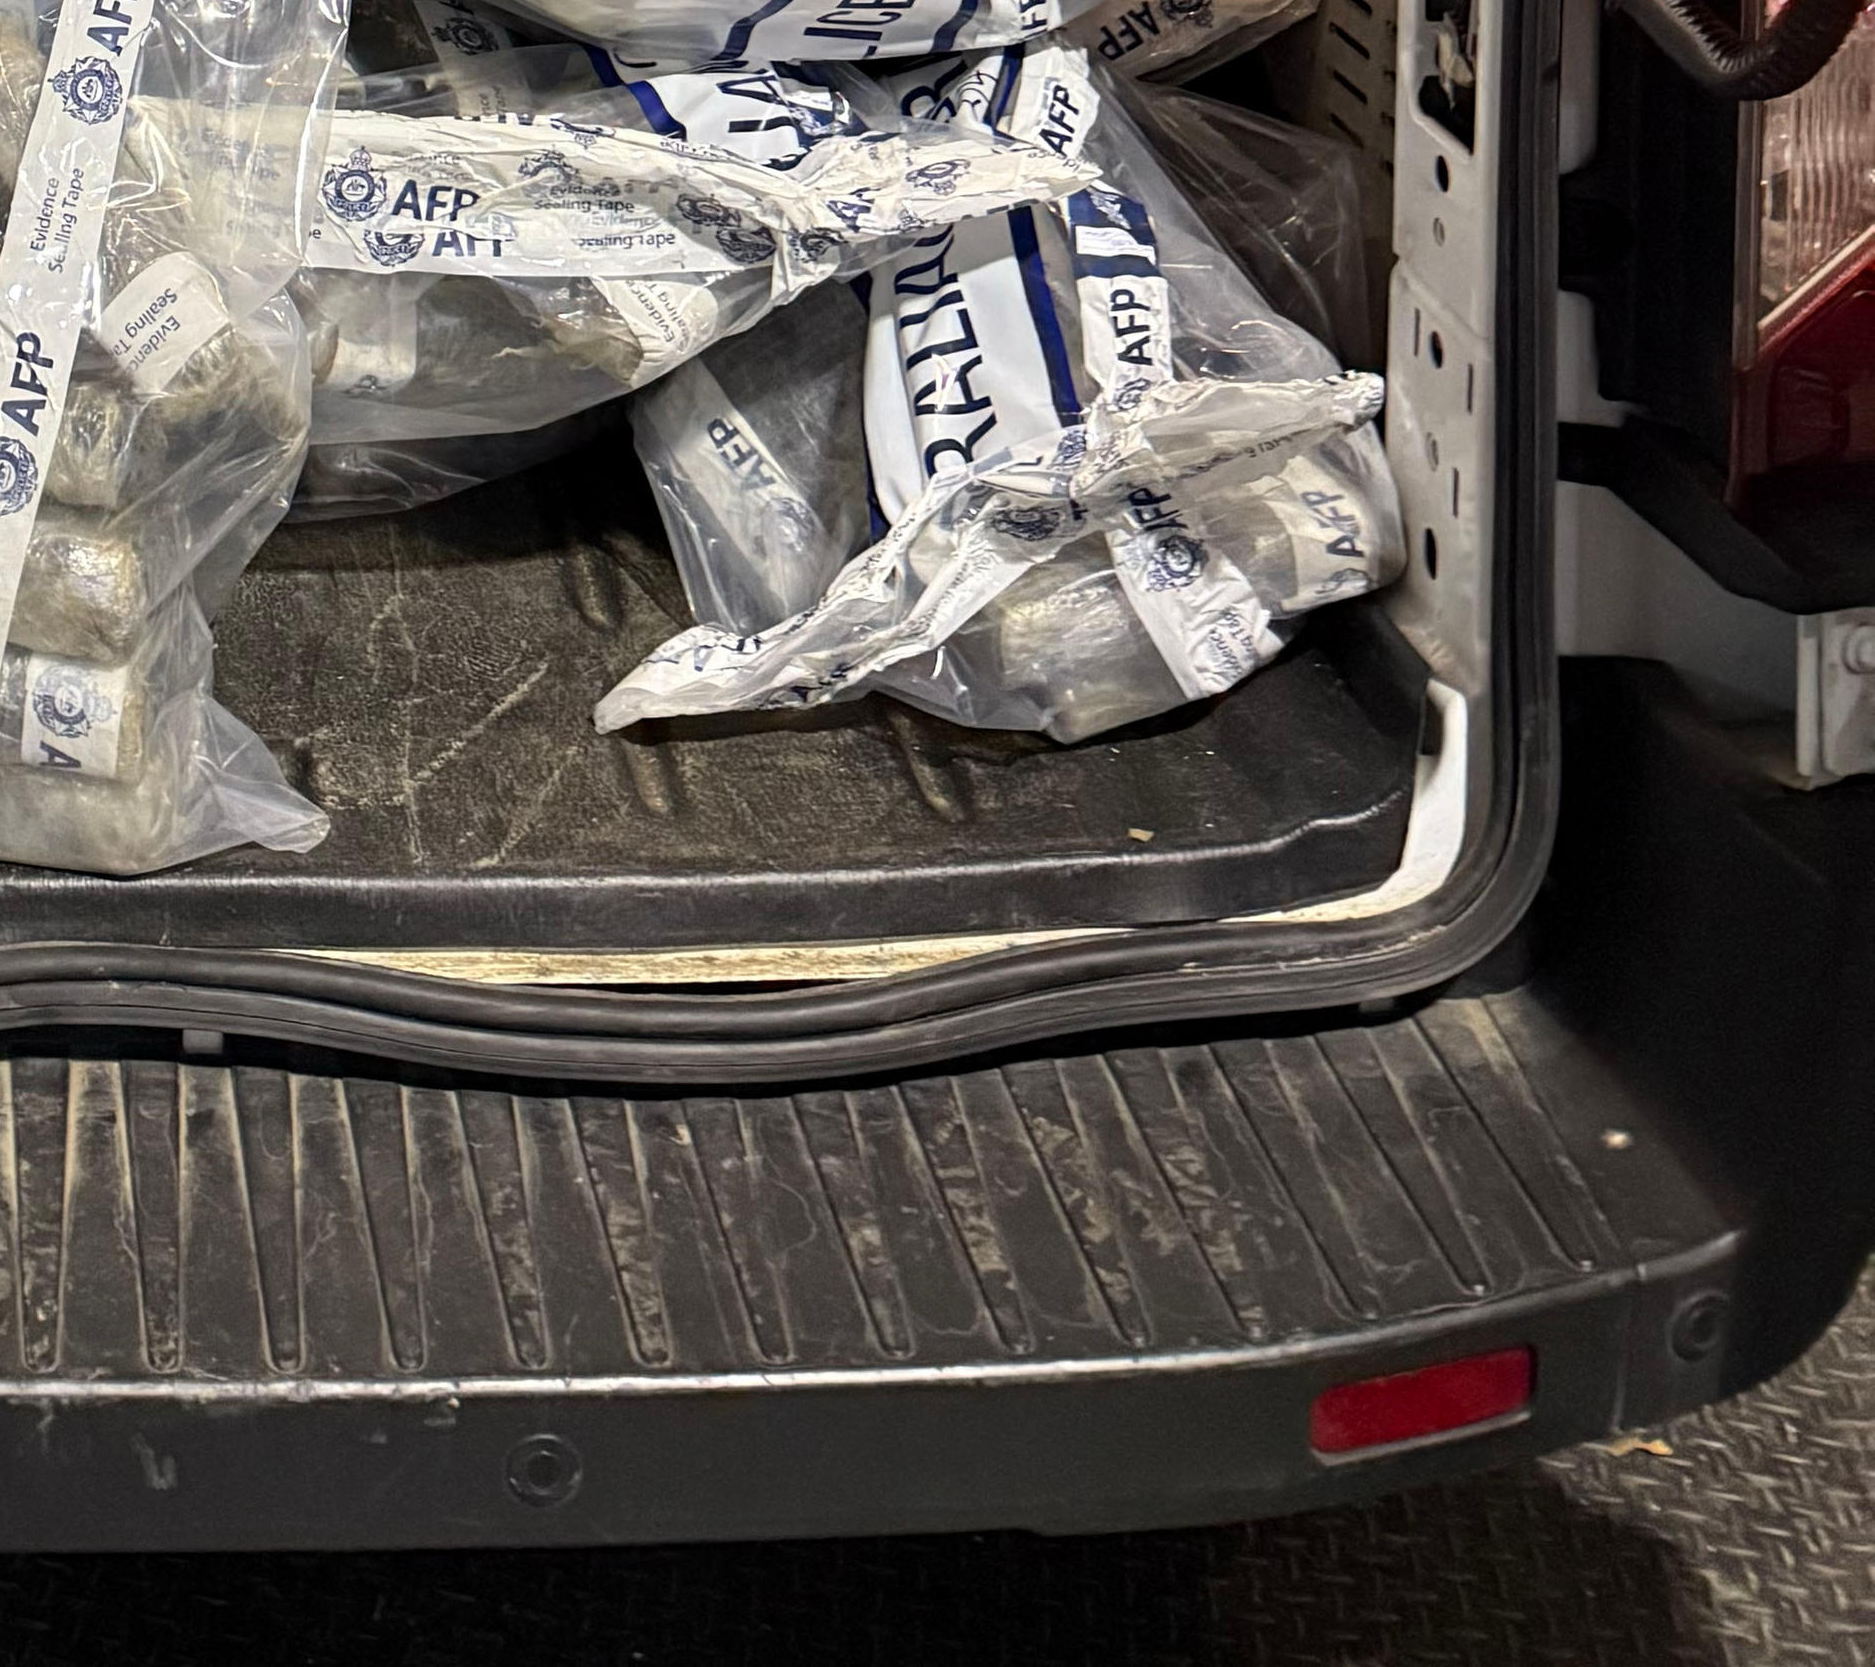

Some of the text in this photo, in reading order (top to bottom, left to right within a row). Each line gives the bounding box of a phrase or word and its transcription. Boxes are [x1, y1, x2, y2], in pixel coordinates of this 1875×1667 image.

[1097, 0, 1160, 61] AFP
[1038, 85, 1081, 158] AFP
[29, 177, 61, 252] Evidence
[49, 167, 85, 273] Sealing Tape
[391, 179, 481, 222] AFP
[533, 198, 636, 214] Sealing Tape
[125, 287, 178, 338] Sealing
[1110, 288, 1153, 366] AFP
[1, 332, 54, 437] AFP
[894, 224, 997, 479] RALIA
[707, 418, 776, 491] AFP
[1300, 490, 1365, 558] AFP
